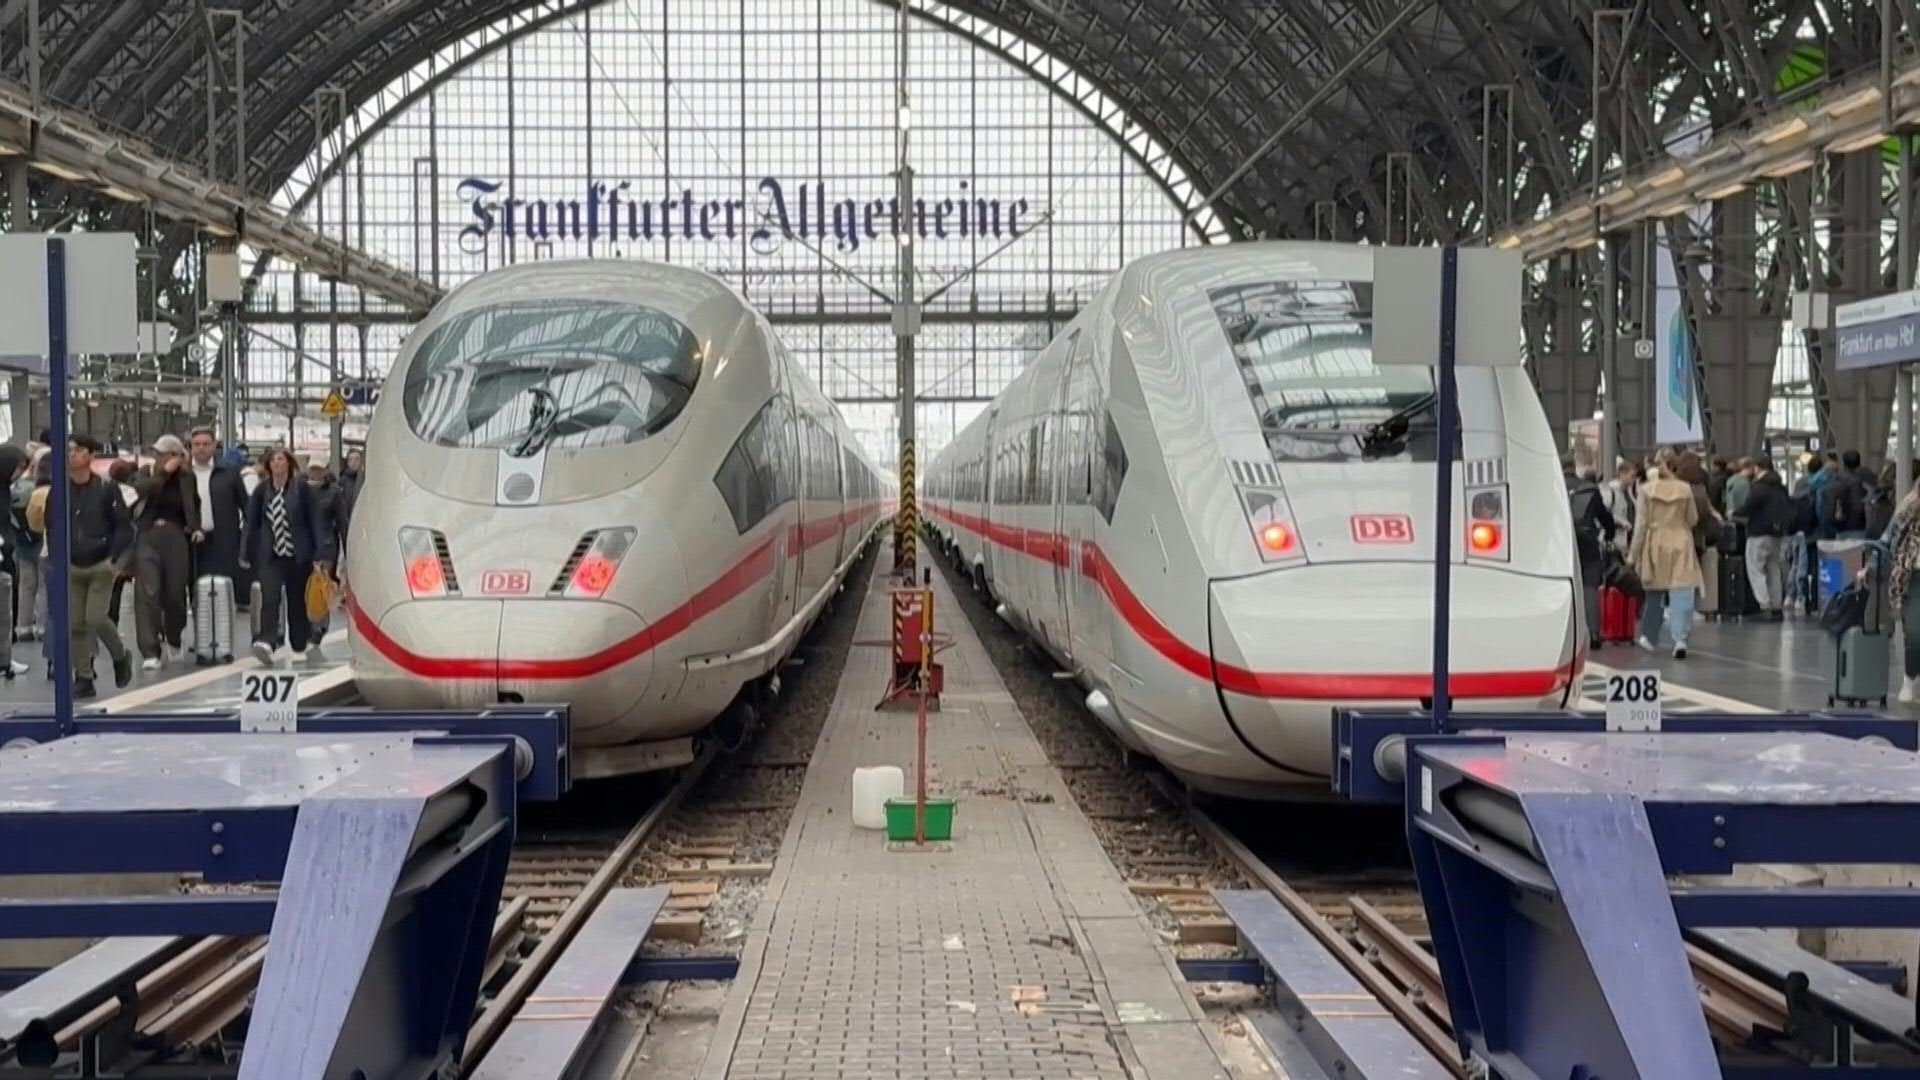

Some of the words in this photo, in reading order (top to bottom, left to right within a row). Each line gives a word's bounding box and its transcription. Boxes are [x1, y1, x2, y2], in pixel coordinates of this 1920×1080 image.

[456, 178, 744, 254] Frankfurter
[750, 176, 1028, 254] Allgemeine
[746, 266, 971, 285] DEUSCHLAND
[1839, 331, 1872, 357] Frankfurt
[1358, 518, 1407, 539] DB
[487, 573, 525, 590] DB
[245, 675, 296, 703] 207
[1609, 675, 1659, 703] 208
[265, 710, 295, 721] 2010
[1631, 710, 1659, 721] 2010
